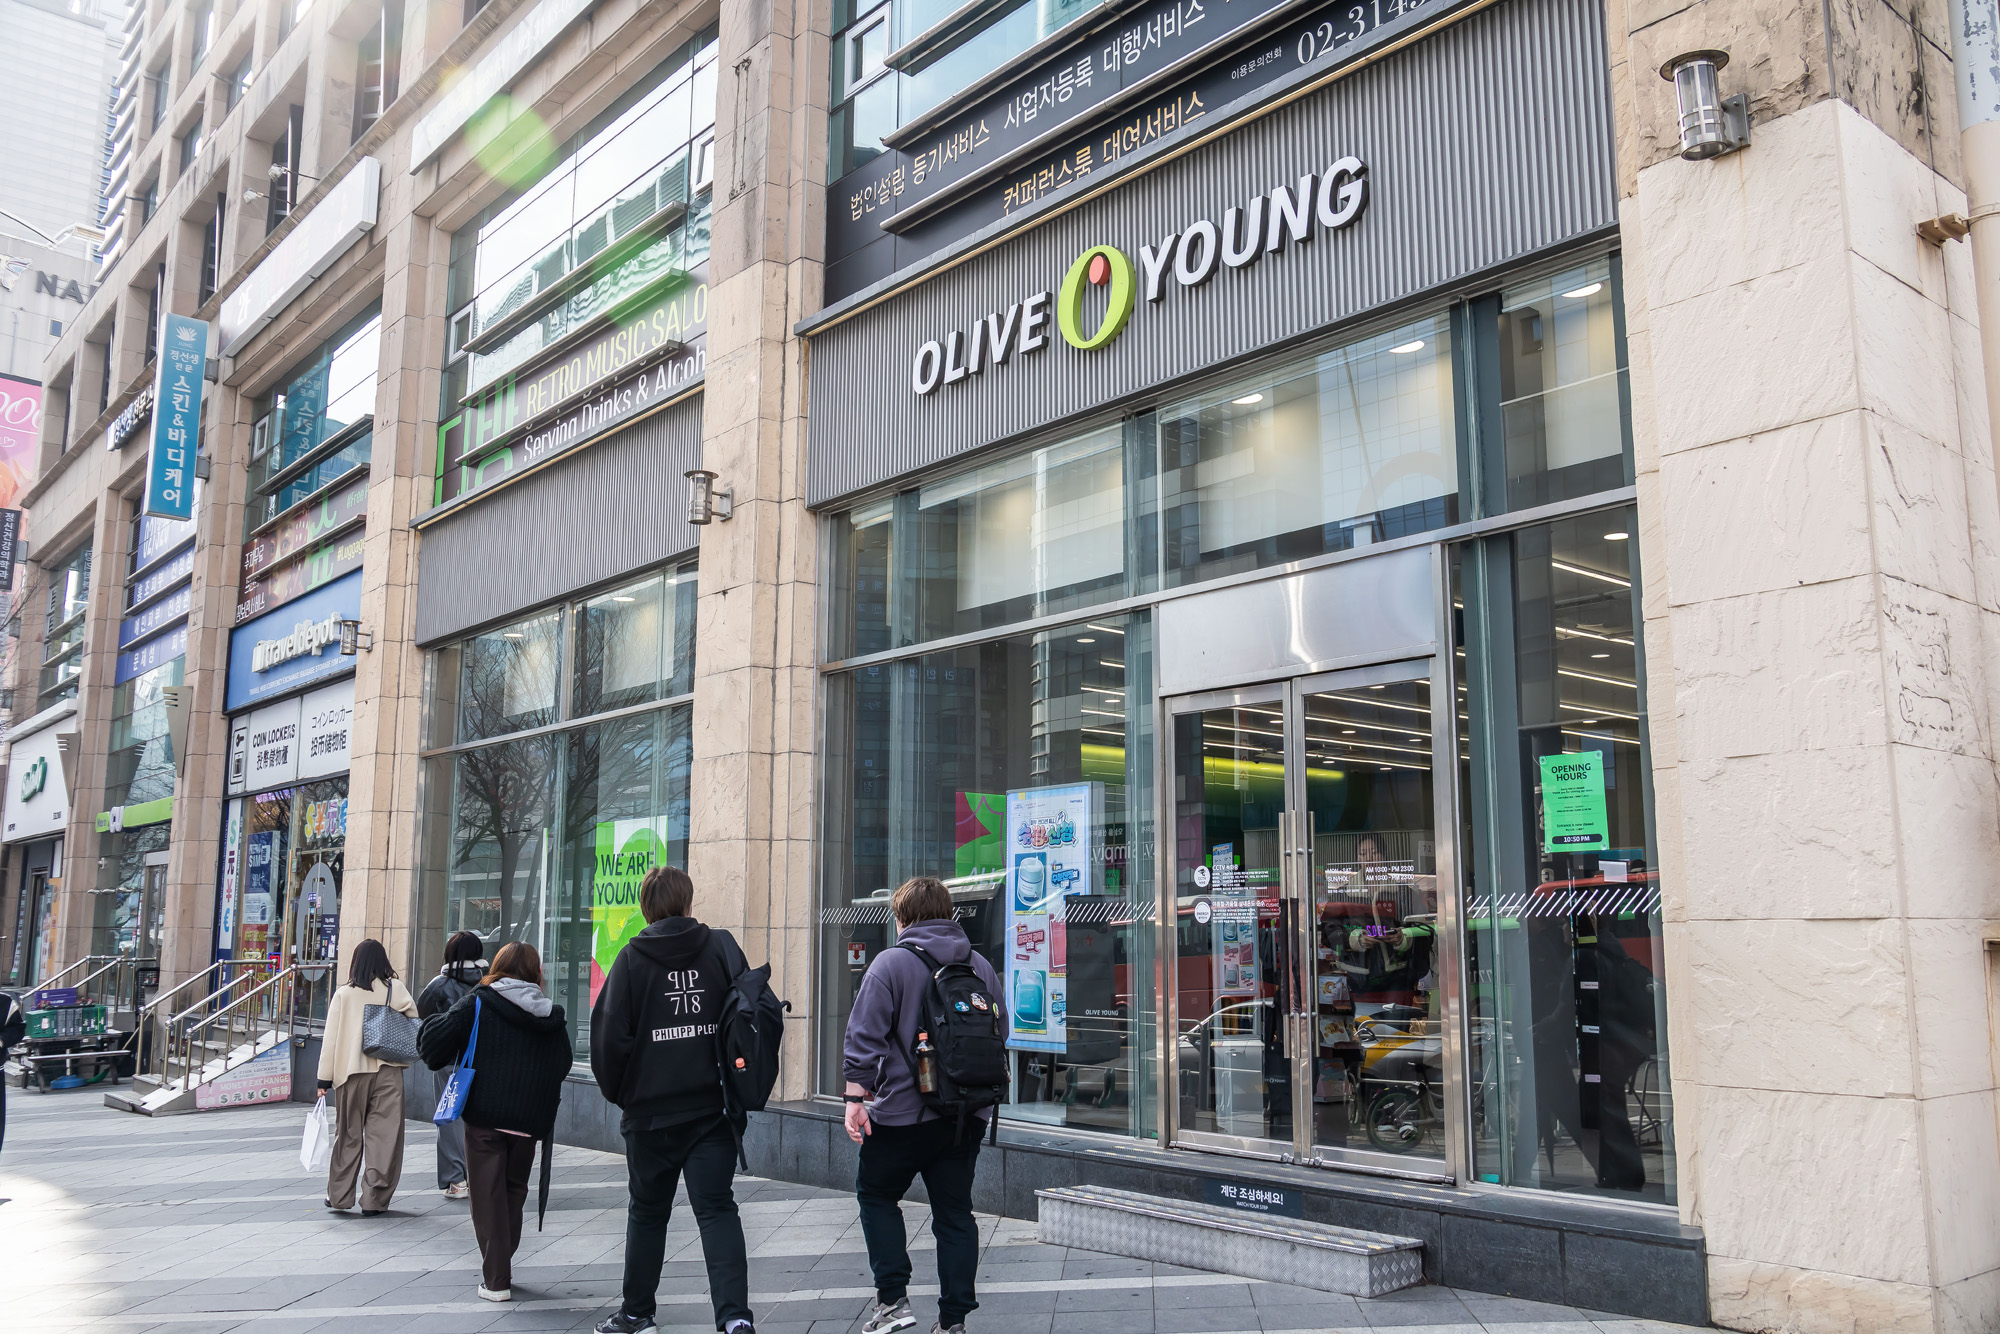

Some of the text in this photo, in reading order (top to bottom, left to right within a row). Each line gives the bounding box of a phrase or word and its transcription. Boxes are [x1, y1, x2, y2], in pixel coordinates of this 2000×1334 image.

[1231, 46, 1282, 80] 이용문의전화
[850, 0, 1206, 222] 법인설립 등기서비스 사업자등록 대행서비스
[1103, 91, 1206, 163] 대여서비스
[912, 290, 1053, 396] OLIVE
[1138, 155, 1370, 303] YOUNG
[170, 349, 199, 365] 정선생
[527, 283, 708, 418] RETRO MUSIC SALO
[175, 362, 193, 373] 전문
[523, 419, 577, 462] Serving
[582, 386, 632, 433] Drinks
[636, 374, 649, 405] &
[162, 375, 191, 508] 스킨&바디케어
[133, 628, 187, 671] 문제성 피부
[264, 611, 342, 667] traveldepot
[312, 706, 353, 729] コインロッカー
[252, 724, 296, 748] COIN LOCKERS
[1551, 763, 1591, 774] OPENING
[1556, 771, 1588, 782] HOURS
[600, 851, 655, 877] WE ARE
[654, 1023, 717, 1041] PHILIPP PLEI
[220, 1075, 289, 1091] MONEY EXCHANGE
[1221, 1185, 1284, 1205] 계단 조심하세요!
